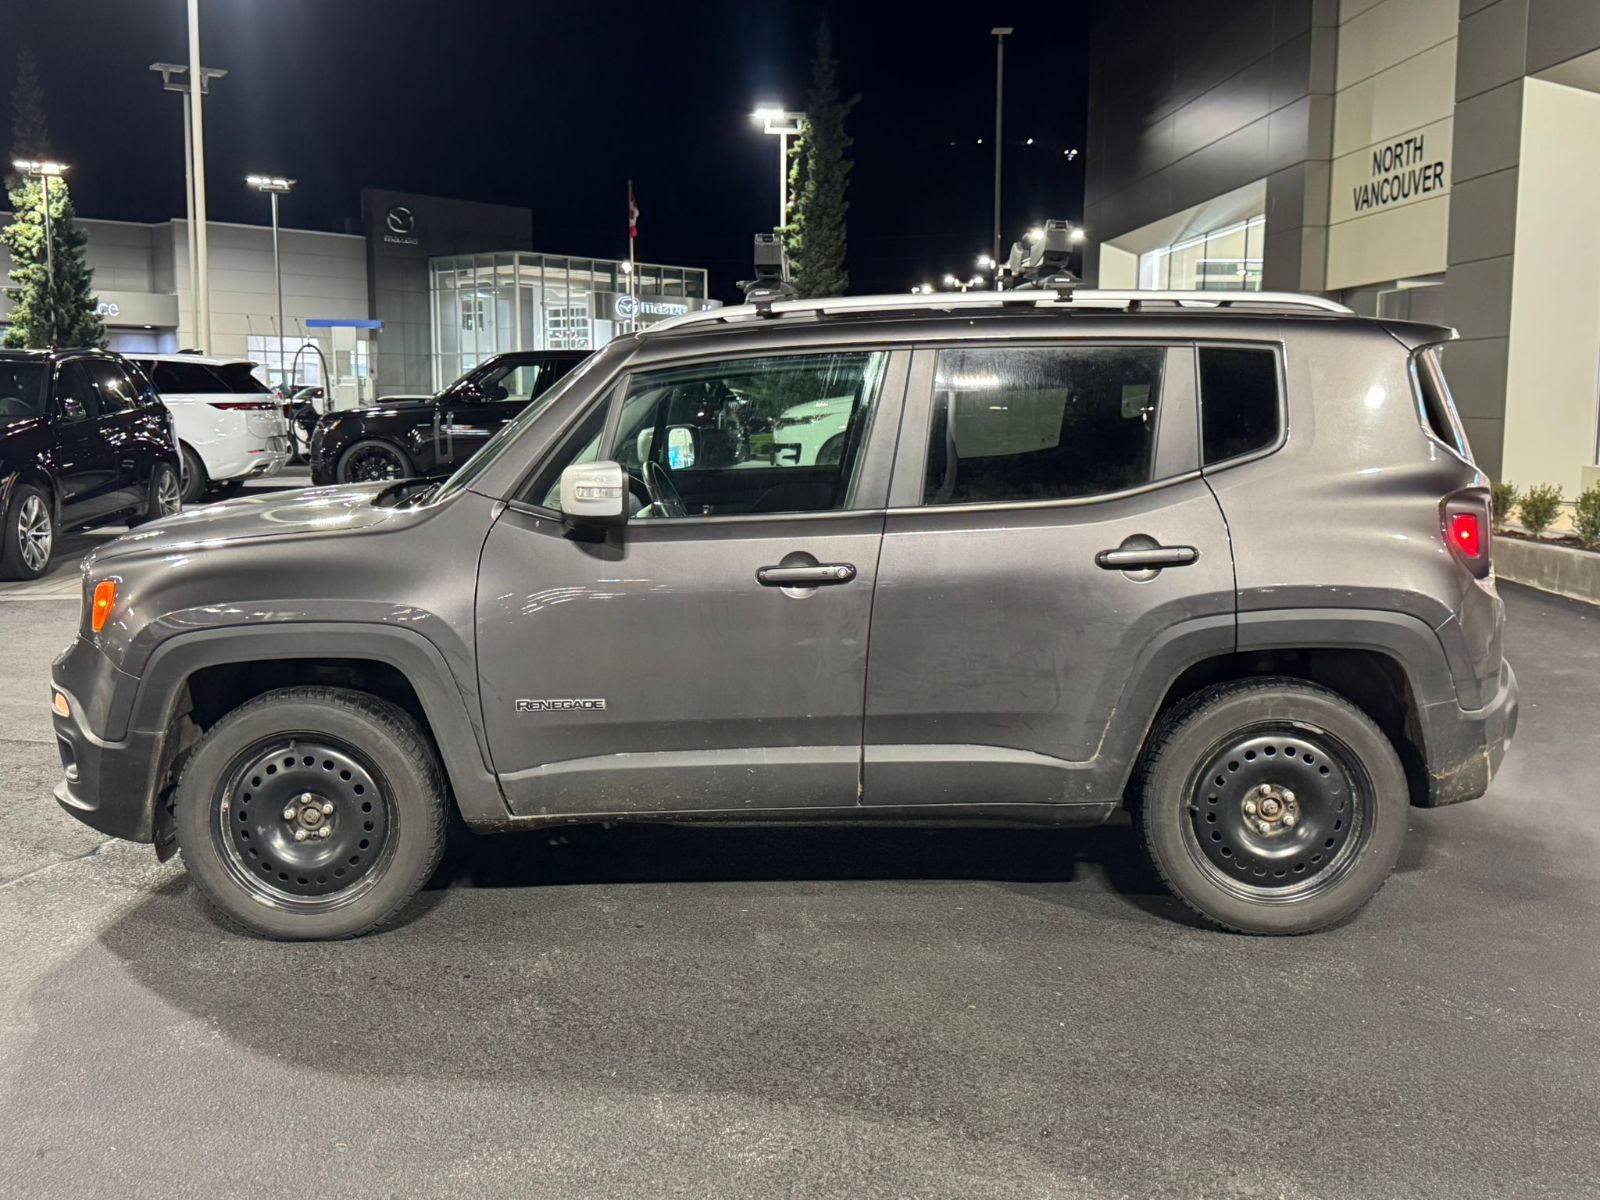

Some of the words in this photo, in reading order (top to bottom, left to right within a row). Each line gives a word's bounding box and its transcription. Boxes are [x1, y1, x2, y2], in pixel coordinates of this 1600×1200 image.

[1372, 134, 1424, 177] NORTH
[1353, 161, 1444, 212] VANCOUVER
[515, 698, 606, 712] RENEGADE
